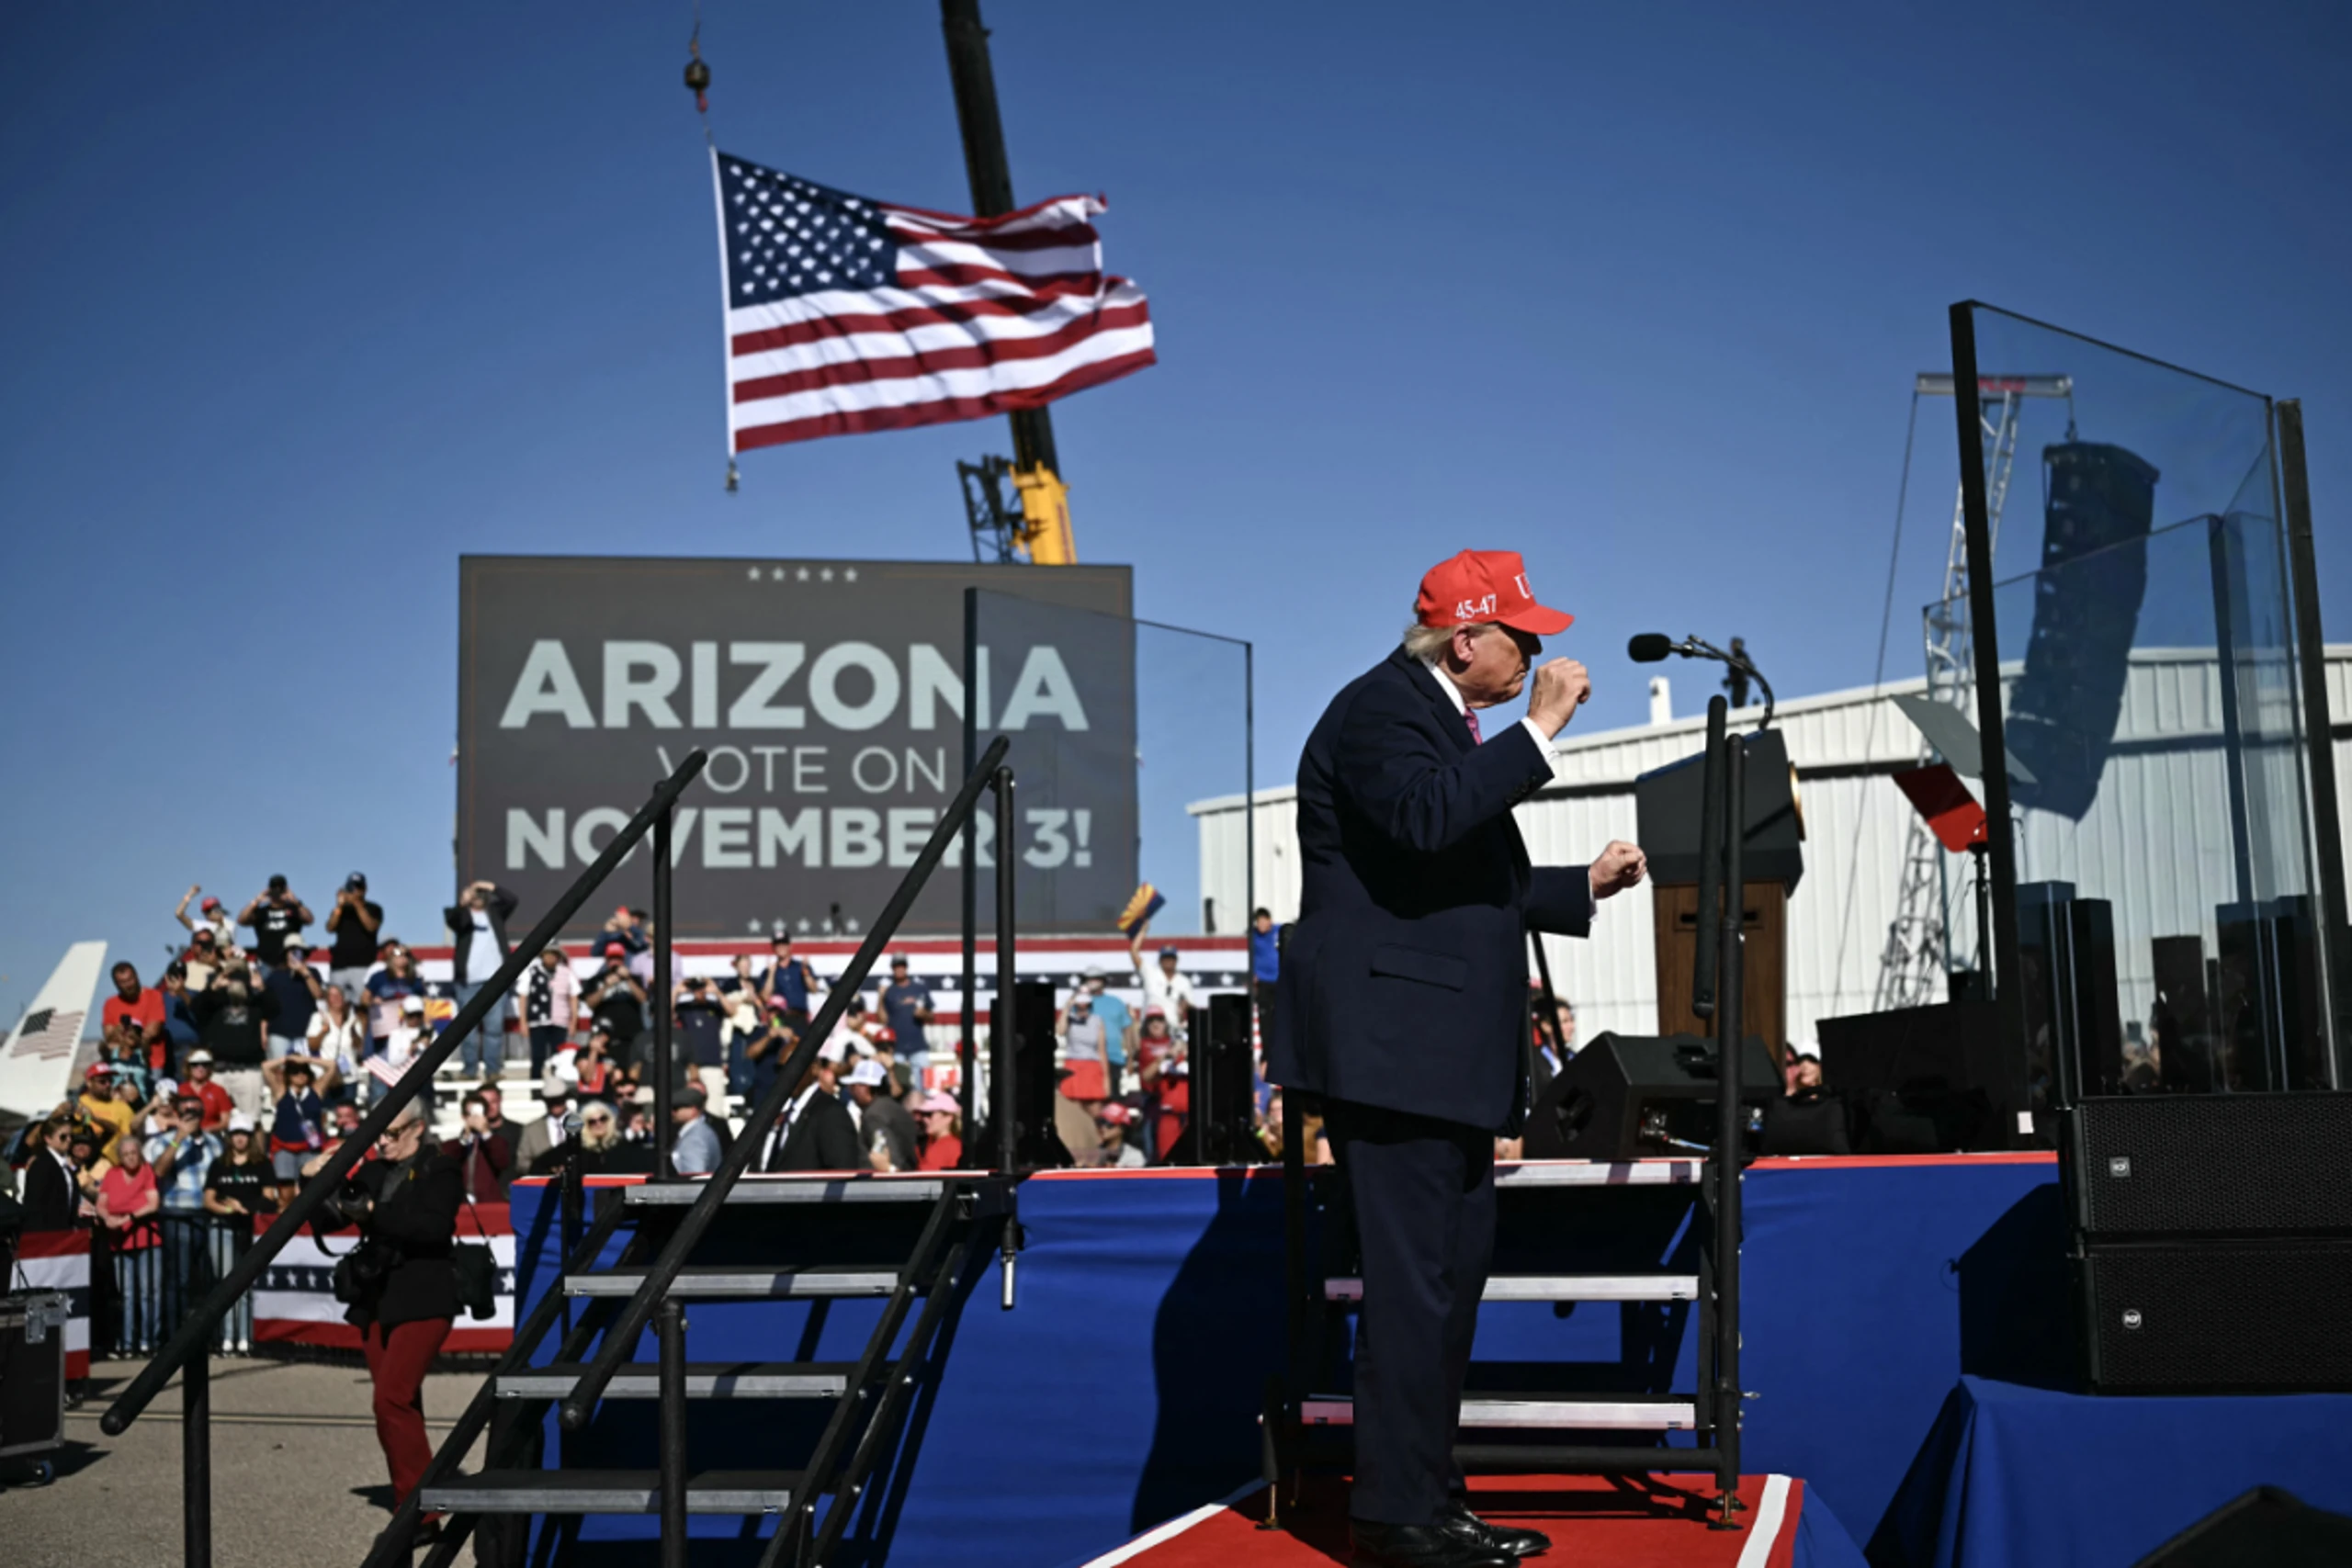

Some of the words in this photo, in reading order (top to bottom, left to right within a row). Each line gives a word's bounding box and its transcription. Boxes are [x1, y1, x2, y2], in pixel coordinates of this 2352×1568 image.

[1455, 593, 1497, 620] 45-47
[499, 639, 1090, 731] ARIZONA
[852, 746, 945, 794] ON
[1022, 808, 1092, 869] 3!
